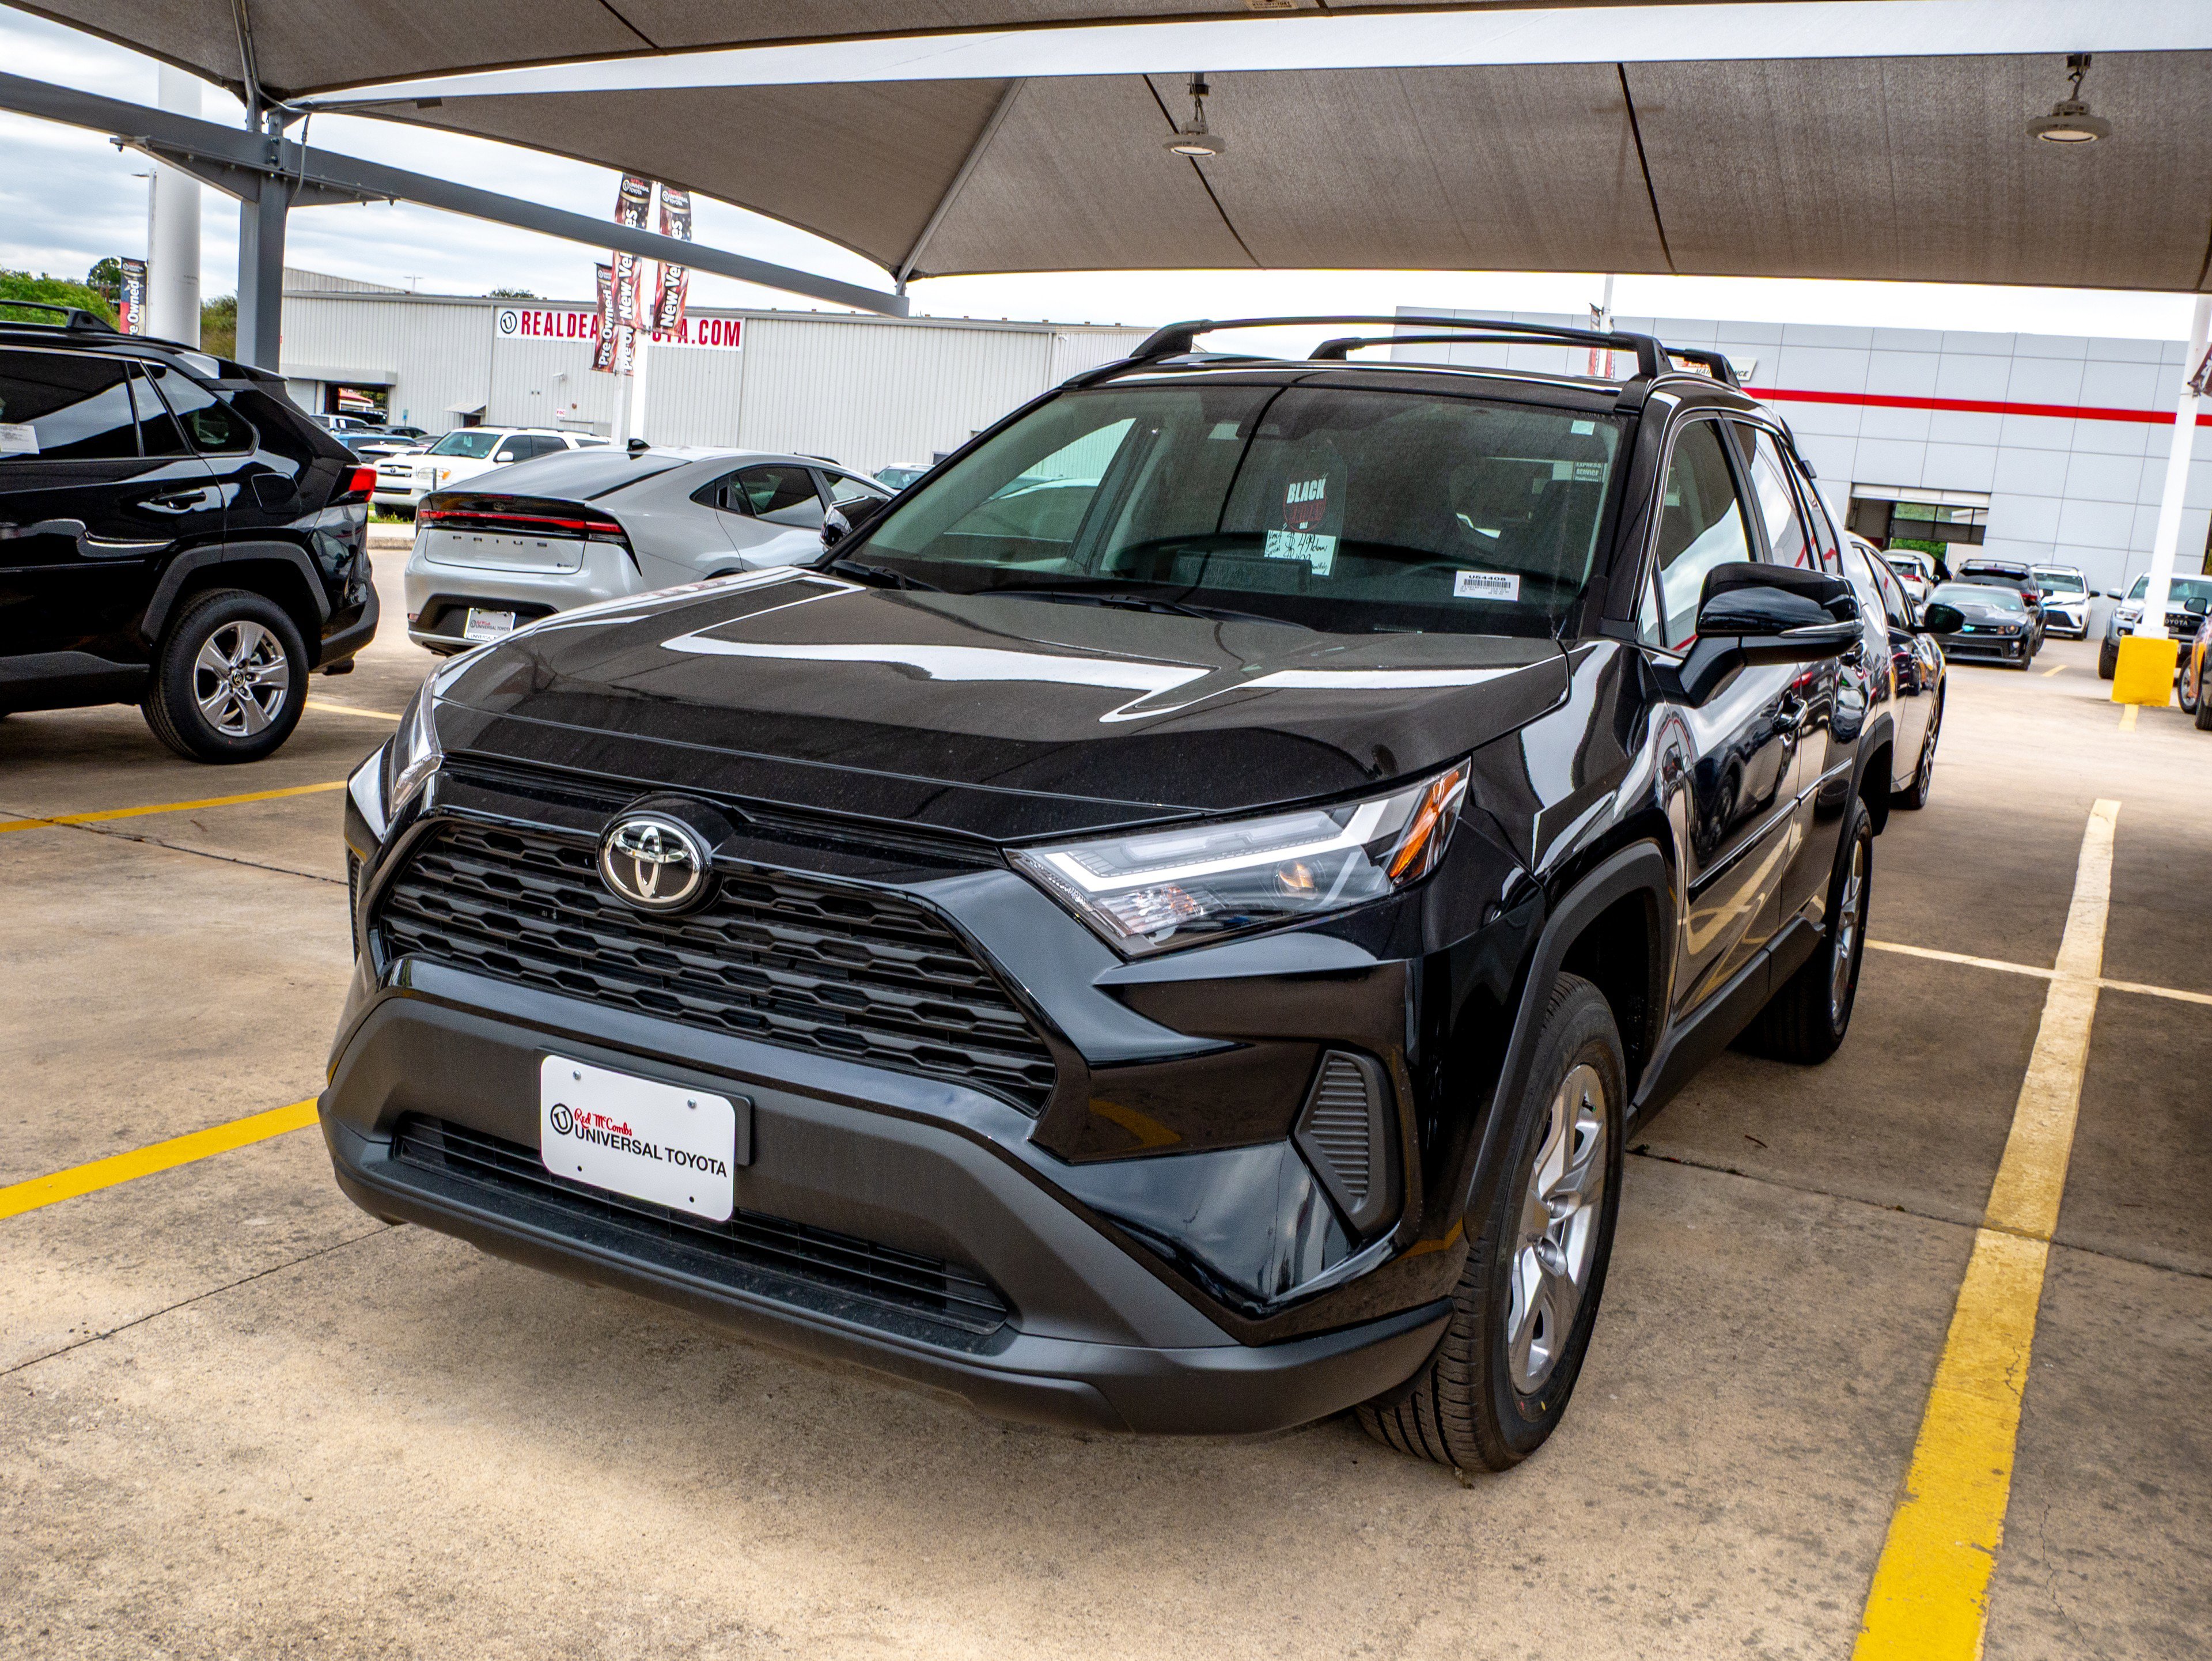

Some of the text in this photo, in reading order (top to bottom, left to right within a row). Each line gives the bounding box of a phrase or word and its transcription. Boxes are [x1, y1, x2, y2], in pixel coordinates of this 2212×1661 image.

[629, 187, 642, 195] TOYOTA
[630, 182, 650, 193] UNIVERSAL
[669, 193, 689, 204] UNIVERSAL
[669, 199, 683, 207] TOYOTA
[127, 279, 140, 324] Owned
[619, 281, 633, 320] New
[660, 290, 679, 327] New
[601, 289, 613, 339] Owned
[599, 342, 611, 366] Pre
[1286, 479, 1326, 504] BLACK
[574, 1108, 592, 1129] Red
[593, 1113, 632, 1136] McCombs
[575, 1123, 728, 1178] UNIVERSAL TOYOTA
